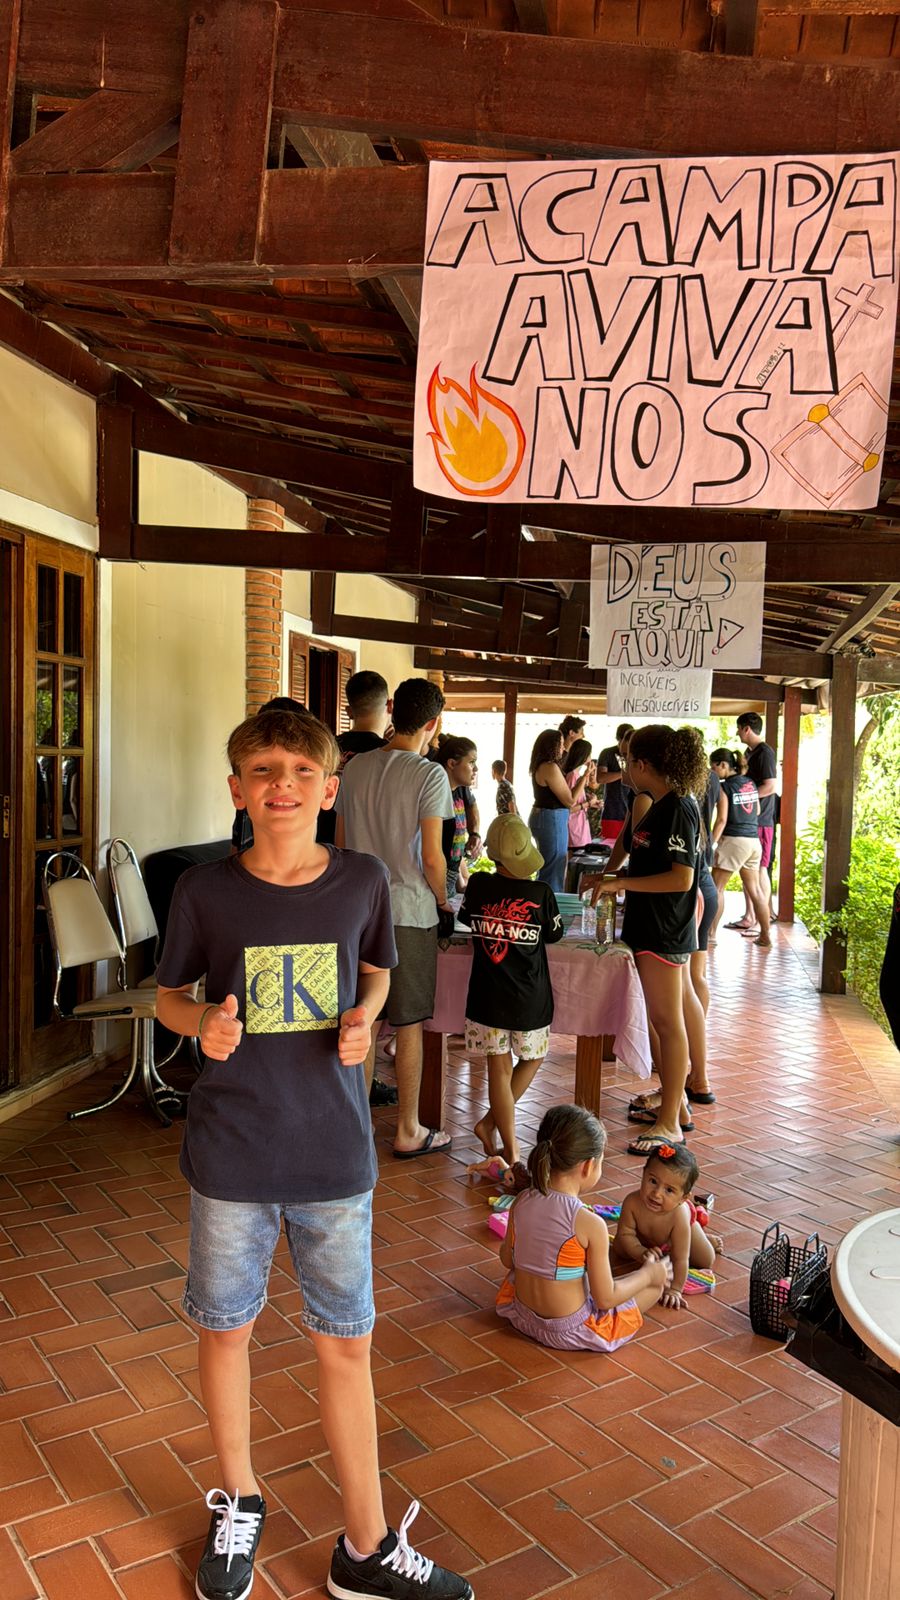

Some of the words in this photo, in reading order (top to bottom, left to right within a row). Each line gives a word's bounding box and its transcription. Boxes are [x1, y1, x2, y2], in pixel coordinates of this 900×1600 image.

[426, 159, 897, 284] ACAMPA
[482, 268, 840, 395] AVIVA
[527, 382, 771, 506] NOS
[607, 543, 737, 604] DEUS
[620, 671, 677, 692] INCRÍVEIS
[623, 697, 700, 713] INESQUECÍVEIS
